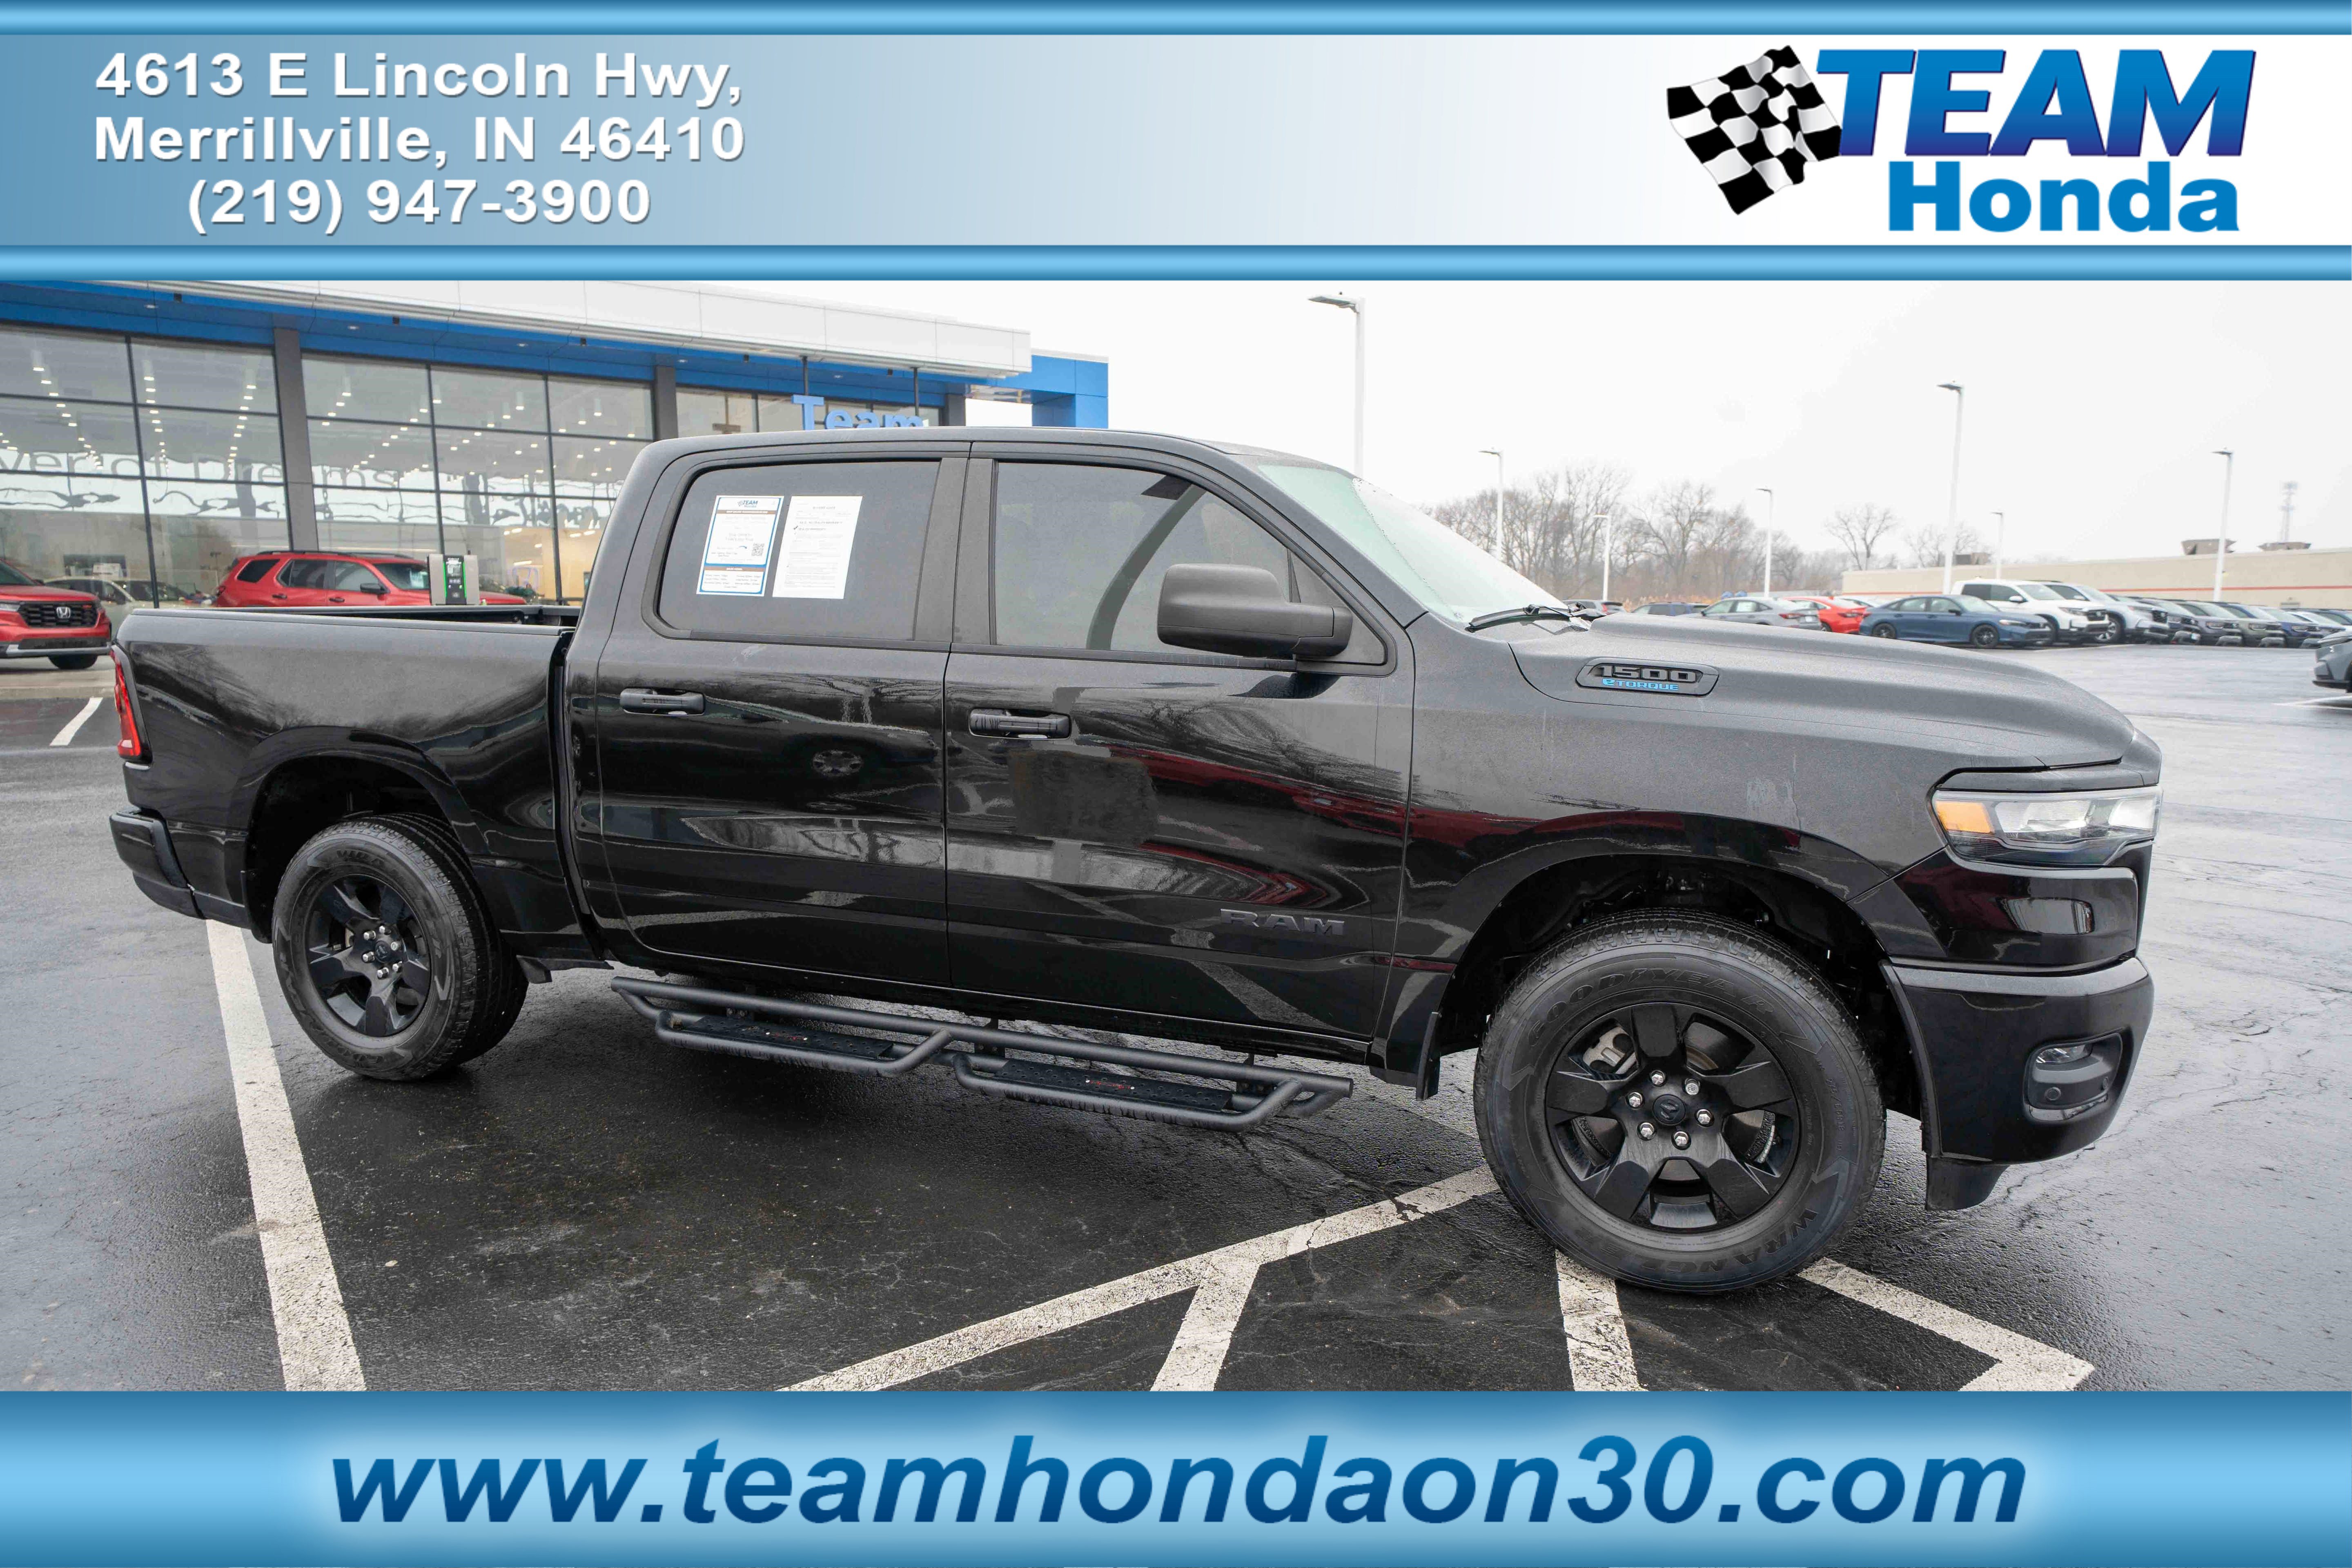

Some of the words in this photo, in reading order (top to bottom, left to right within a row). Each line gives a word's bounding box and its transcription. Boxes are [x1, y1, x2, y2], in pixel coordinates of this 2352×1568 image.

[791, 394, 924, 430] Team
[193, 452, 399, 488] Drems
[1599, 665, 1697, 683] 1500
[1220, 908, 1345, 935] RAM
[1528, 968, 1774, 1047] GOODYEAR
